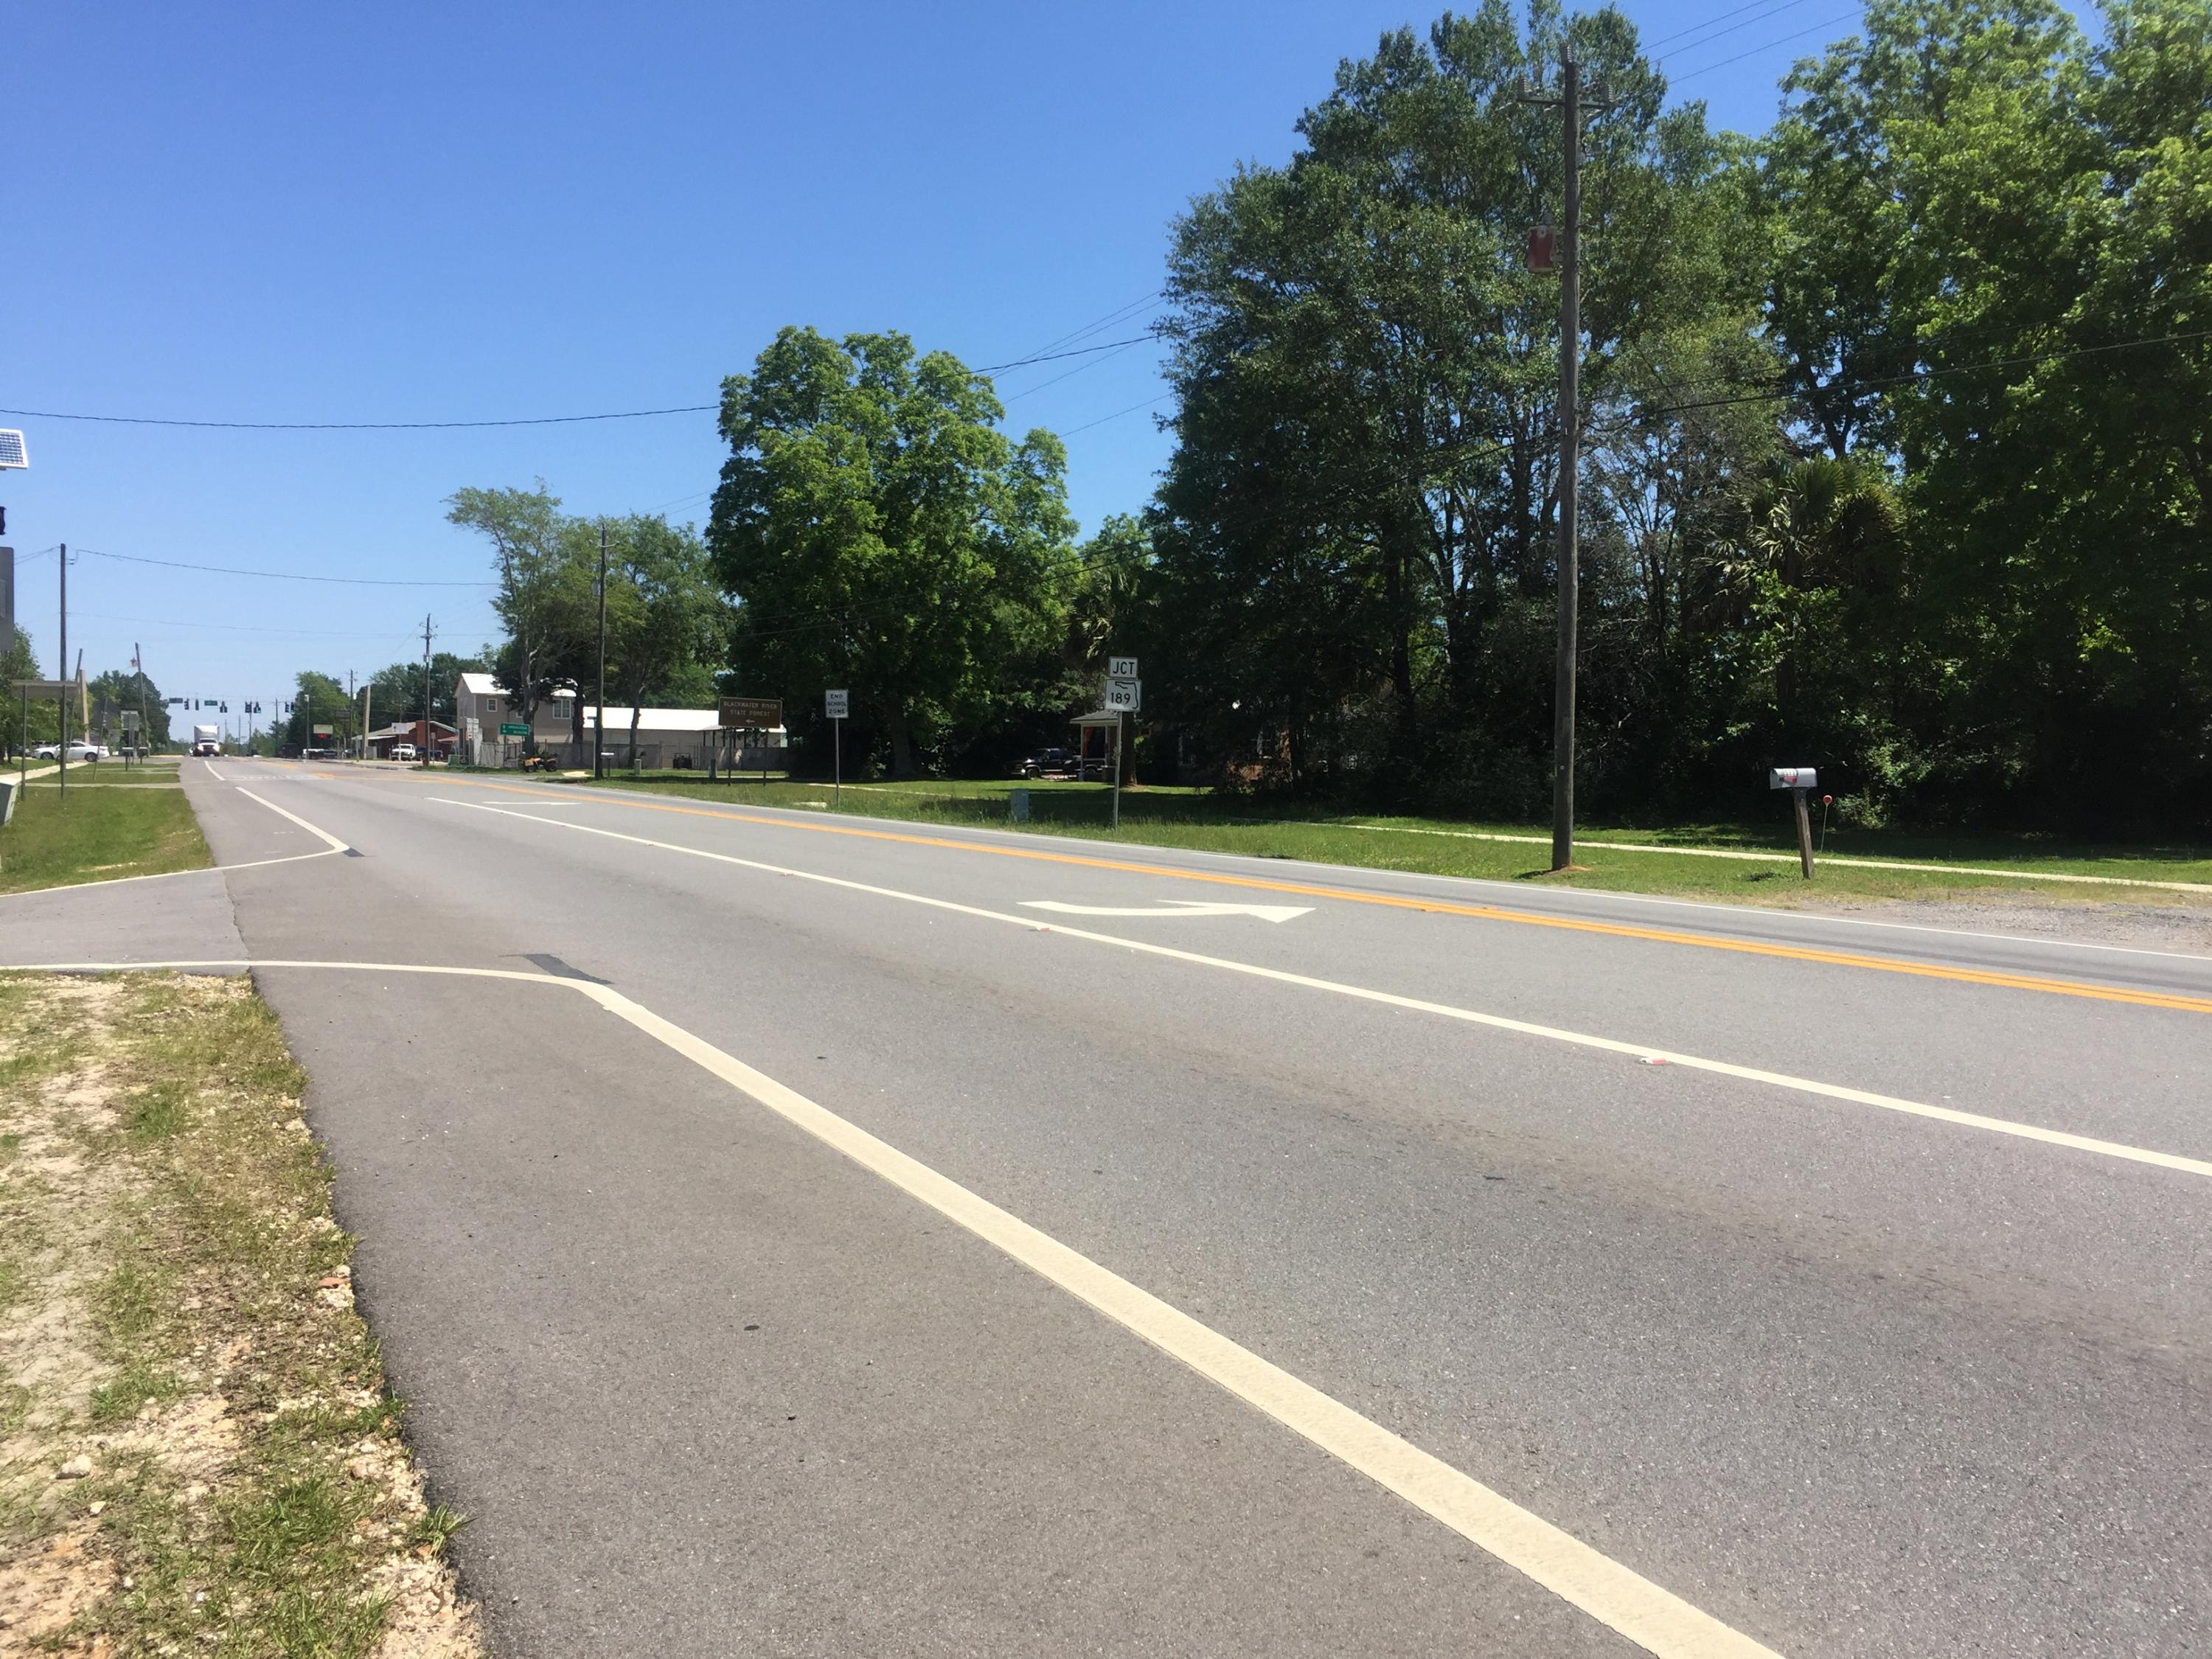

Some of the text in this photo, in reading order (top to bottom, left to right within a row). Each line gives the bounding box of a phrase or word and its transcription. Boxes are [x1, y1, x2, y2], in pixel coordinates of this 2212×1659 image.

[1113, 661, 1135, 675] JCT
[1110, 692, 1131, 704] 189
[723, 700, 759, 709] BLACKWATER
